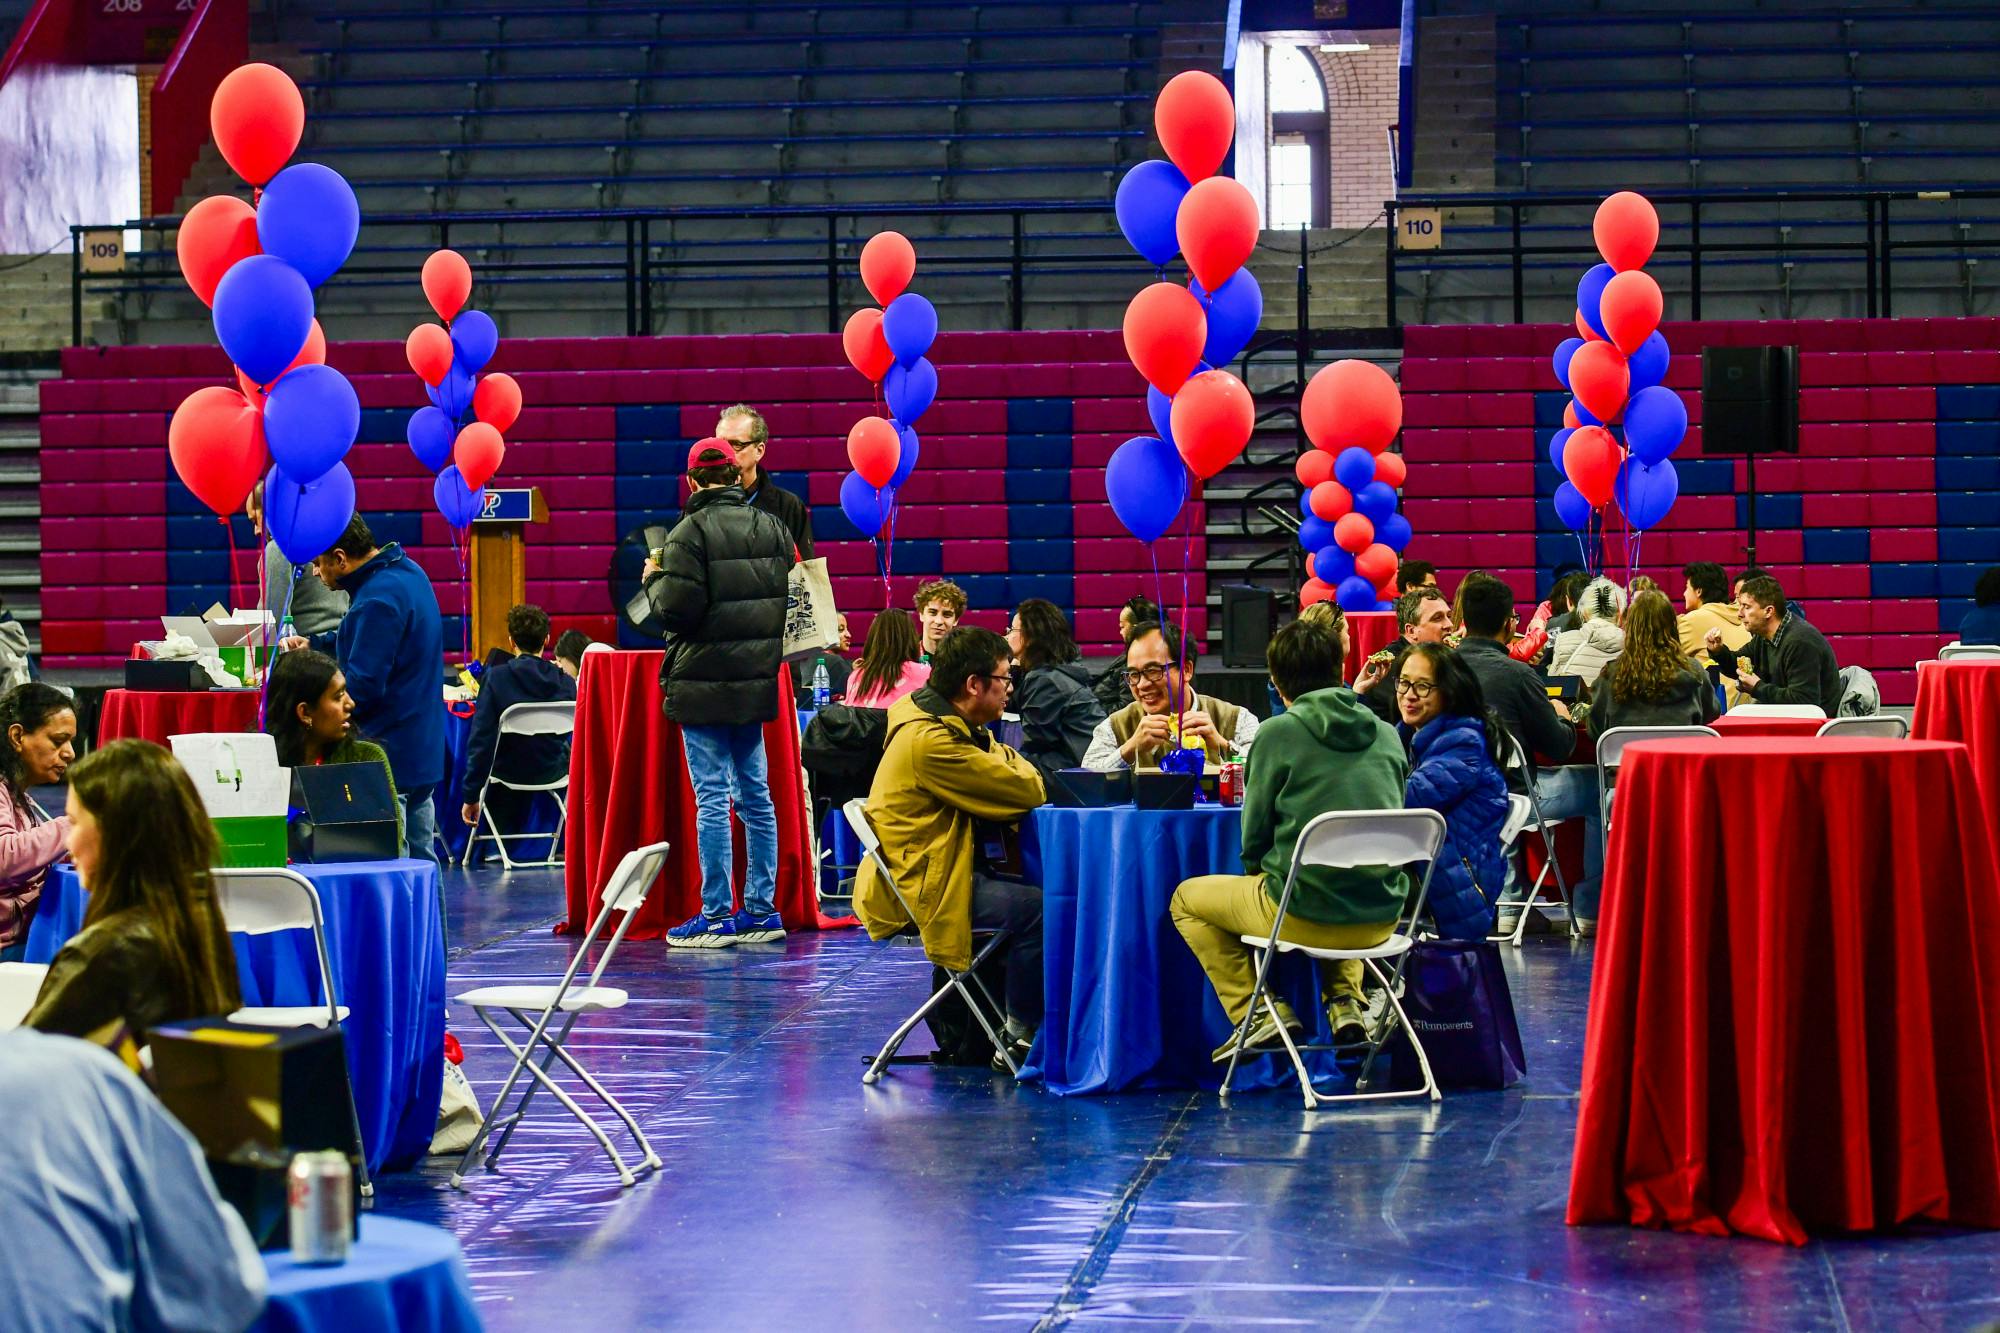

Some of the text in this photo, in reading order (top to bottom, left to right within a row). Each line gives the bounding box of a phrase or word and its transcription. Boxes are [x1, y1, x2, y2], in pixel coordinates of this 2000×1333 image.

[104, 0, 141, 12] 208
[1450, 175, 1456, 184] 5
[1405, 220, 1433, 235] 110
[91, 244, 118, 257] 109
